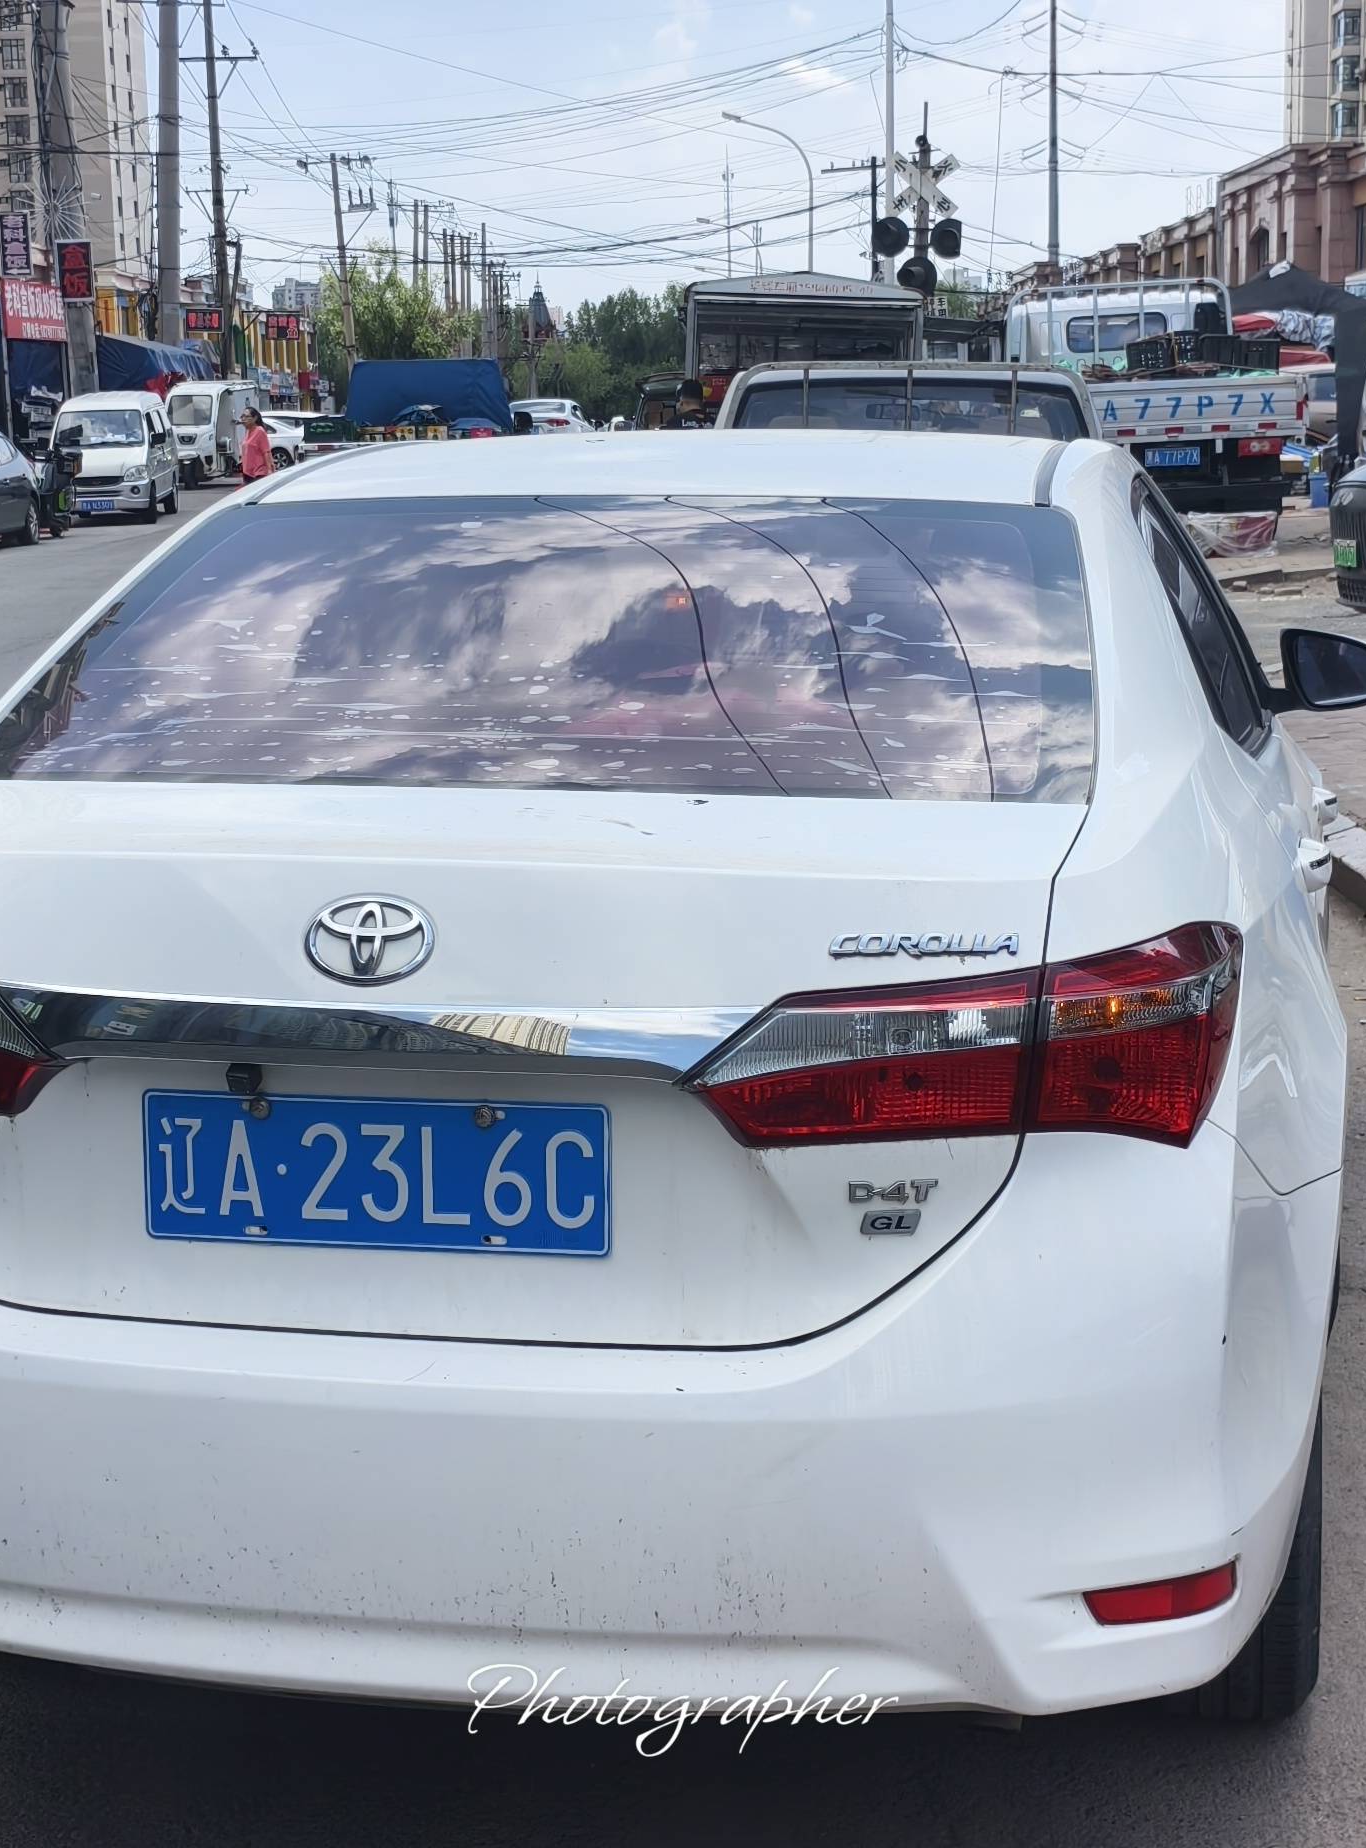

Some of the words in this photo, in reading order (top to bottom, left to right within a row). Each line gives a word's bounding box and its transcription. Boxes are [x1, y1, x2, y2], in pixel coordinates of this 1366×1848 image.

[3, 216, 28, 268] 老科盒饭
[61, 245, 90, 296] 盒饭
[828, 931, 1020, 957] COROLLA
[848, 1178, 939, 1204] D-4T
[869, 1214, 912, 1231] GL
